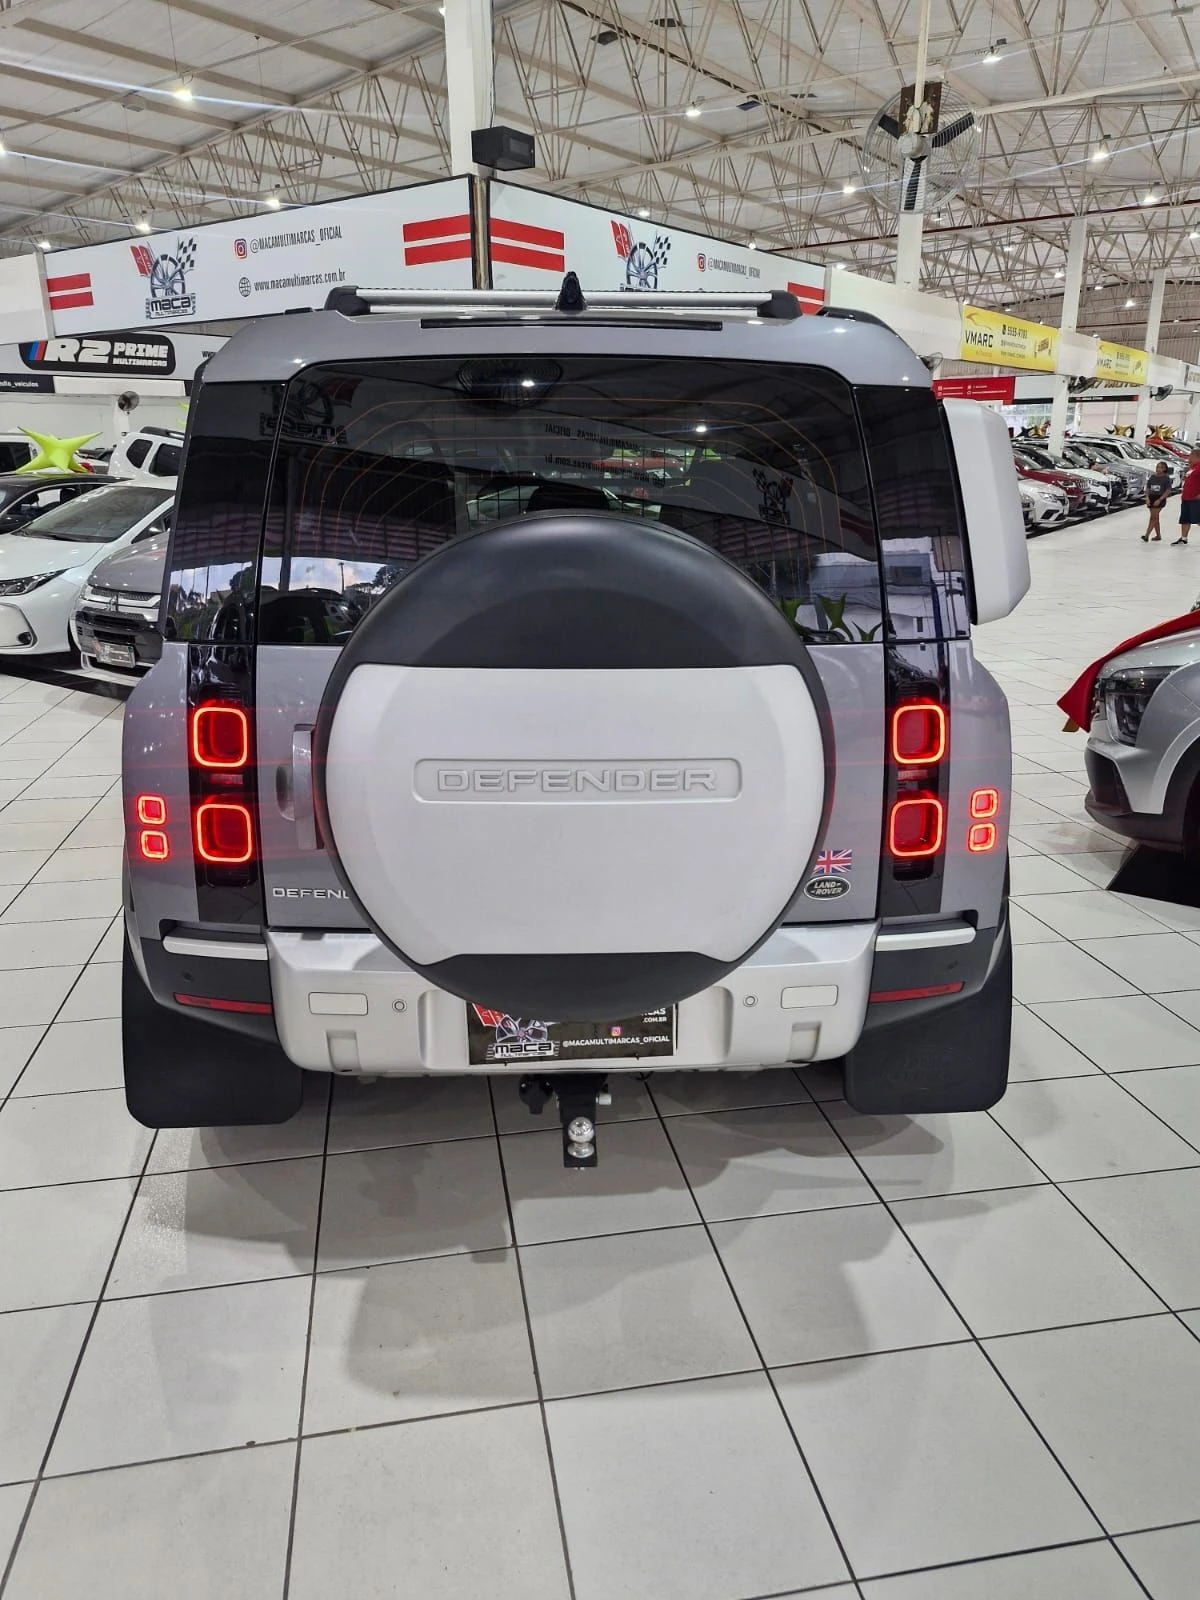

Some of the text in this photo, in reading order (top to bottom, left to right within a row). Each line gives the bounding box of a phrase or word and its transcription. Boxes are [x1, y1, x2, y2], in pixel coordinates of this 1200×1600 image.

[250, 225, 342, 253] @MACAMULTIMARCAS_OFICIAL
[254, 267, 346, 291] www.macamultimarcas.com.br
[965, 330, 994, 348] VMARC
[113, 342, 169, 358] PRIME
[437, 768, 717, 793] DEFENDER
[562, 1035, 670, 1048] @MACAMULTIMARCAS_OFICIAL
